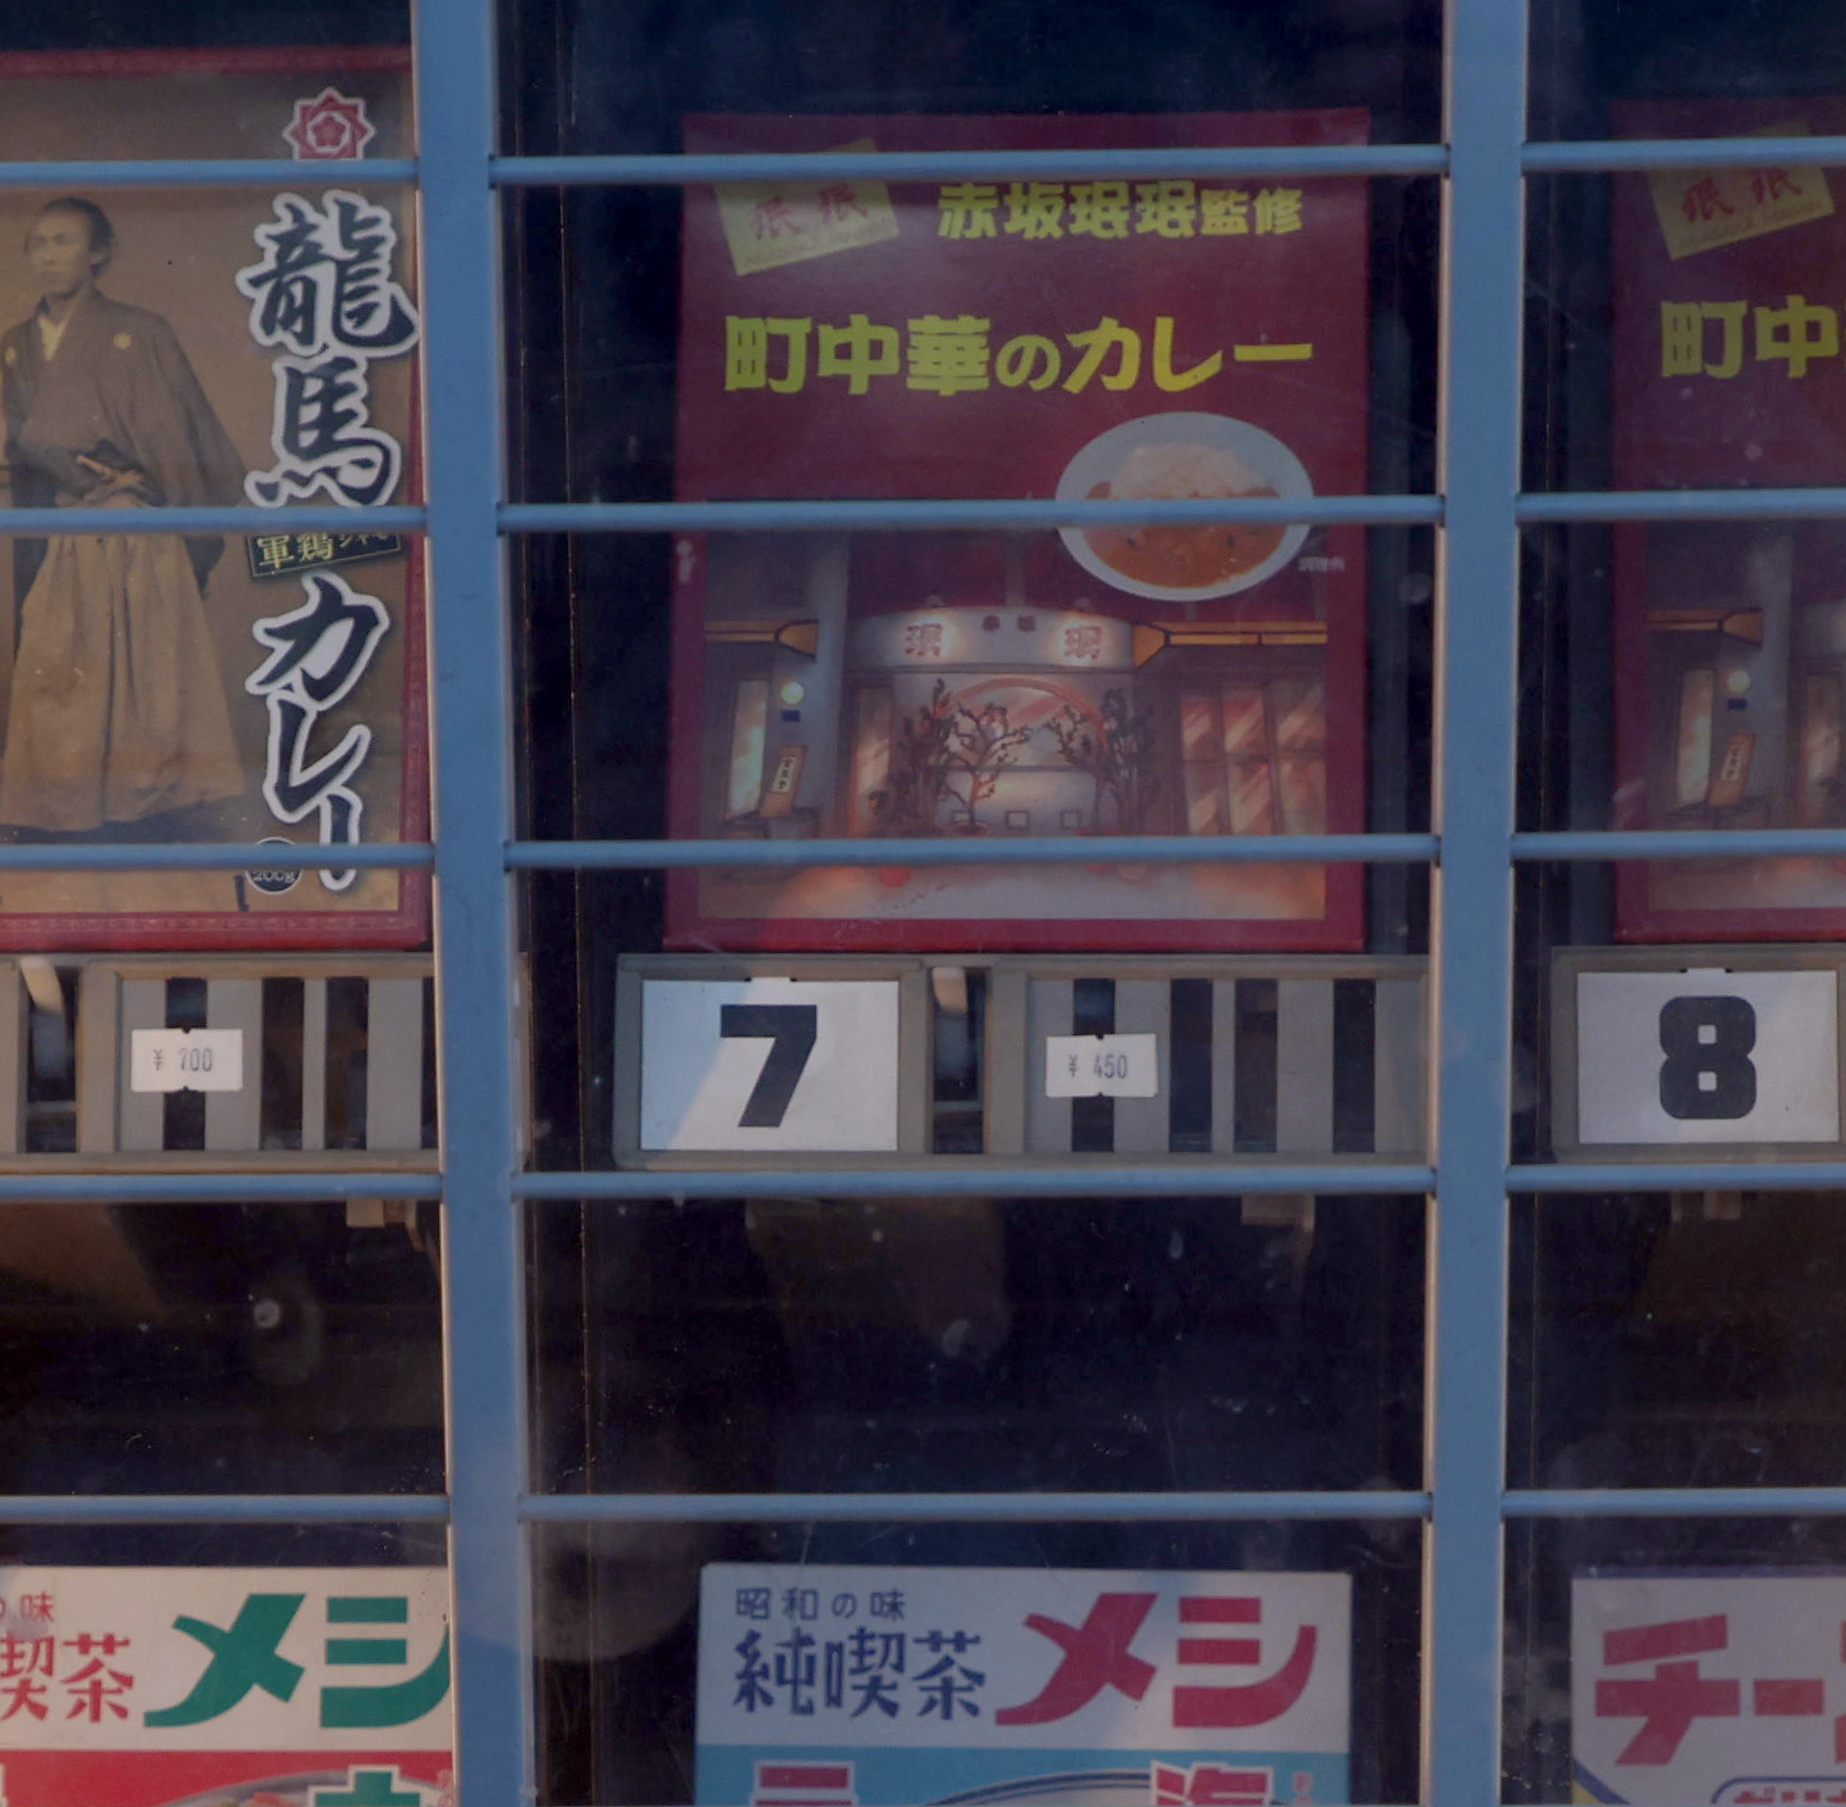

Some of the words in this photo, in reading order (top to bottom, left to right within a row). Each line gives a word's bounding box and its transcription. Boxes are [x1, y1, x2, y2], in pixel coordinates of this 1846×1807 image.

[724, 314, 1313, 396] 町中華のカレー
[720, 1005, 817, 1128] 7
[1093, 1054, 1128, 1078] 450
[1660, 996, 1756, 1119] 8
[736, 1588, 906, 1621] 昭和の味
[144, 1594, 451, 1728] メシ
[734, 1628, 986, 1721] 純喫茶
[995, 1593, 1318, 1728] メシ
